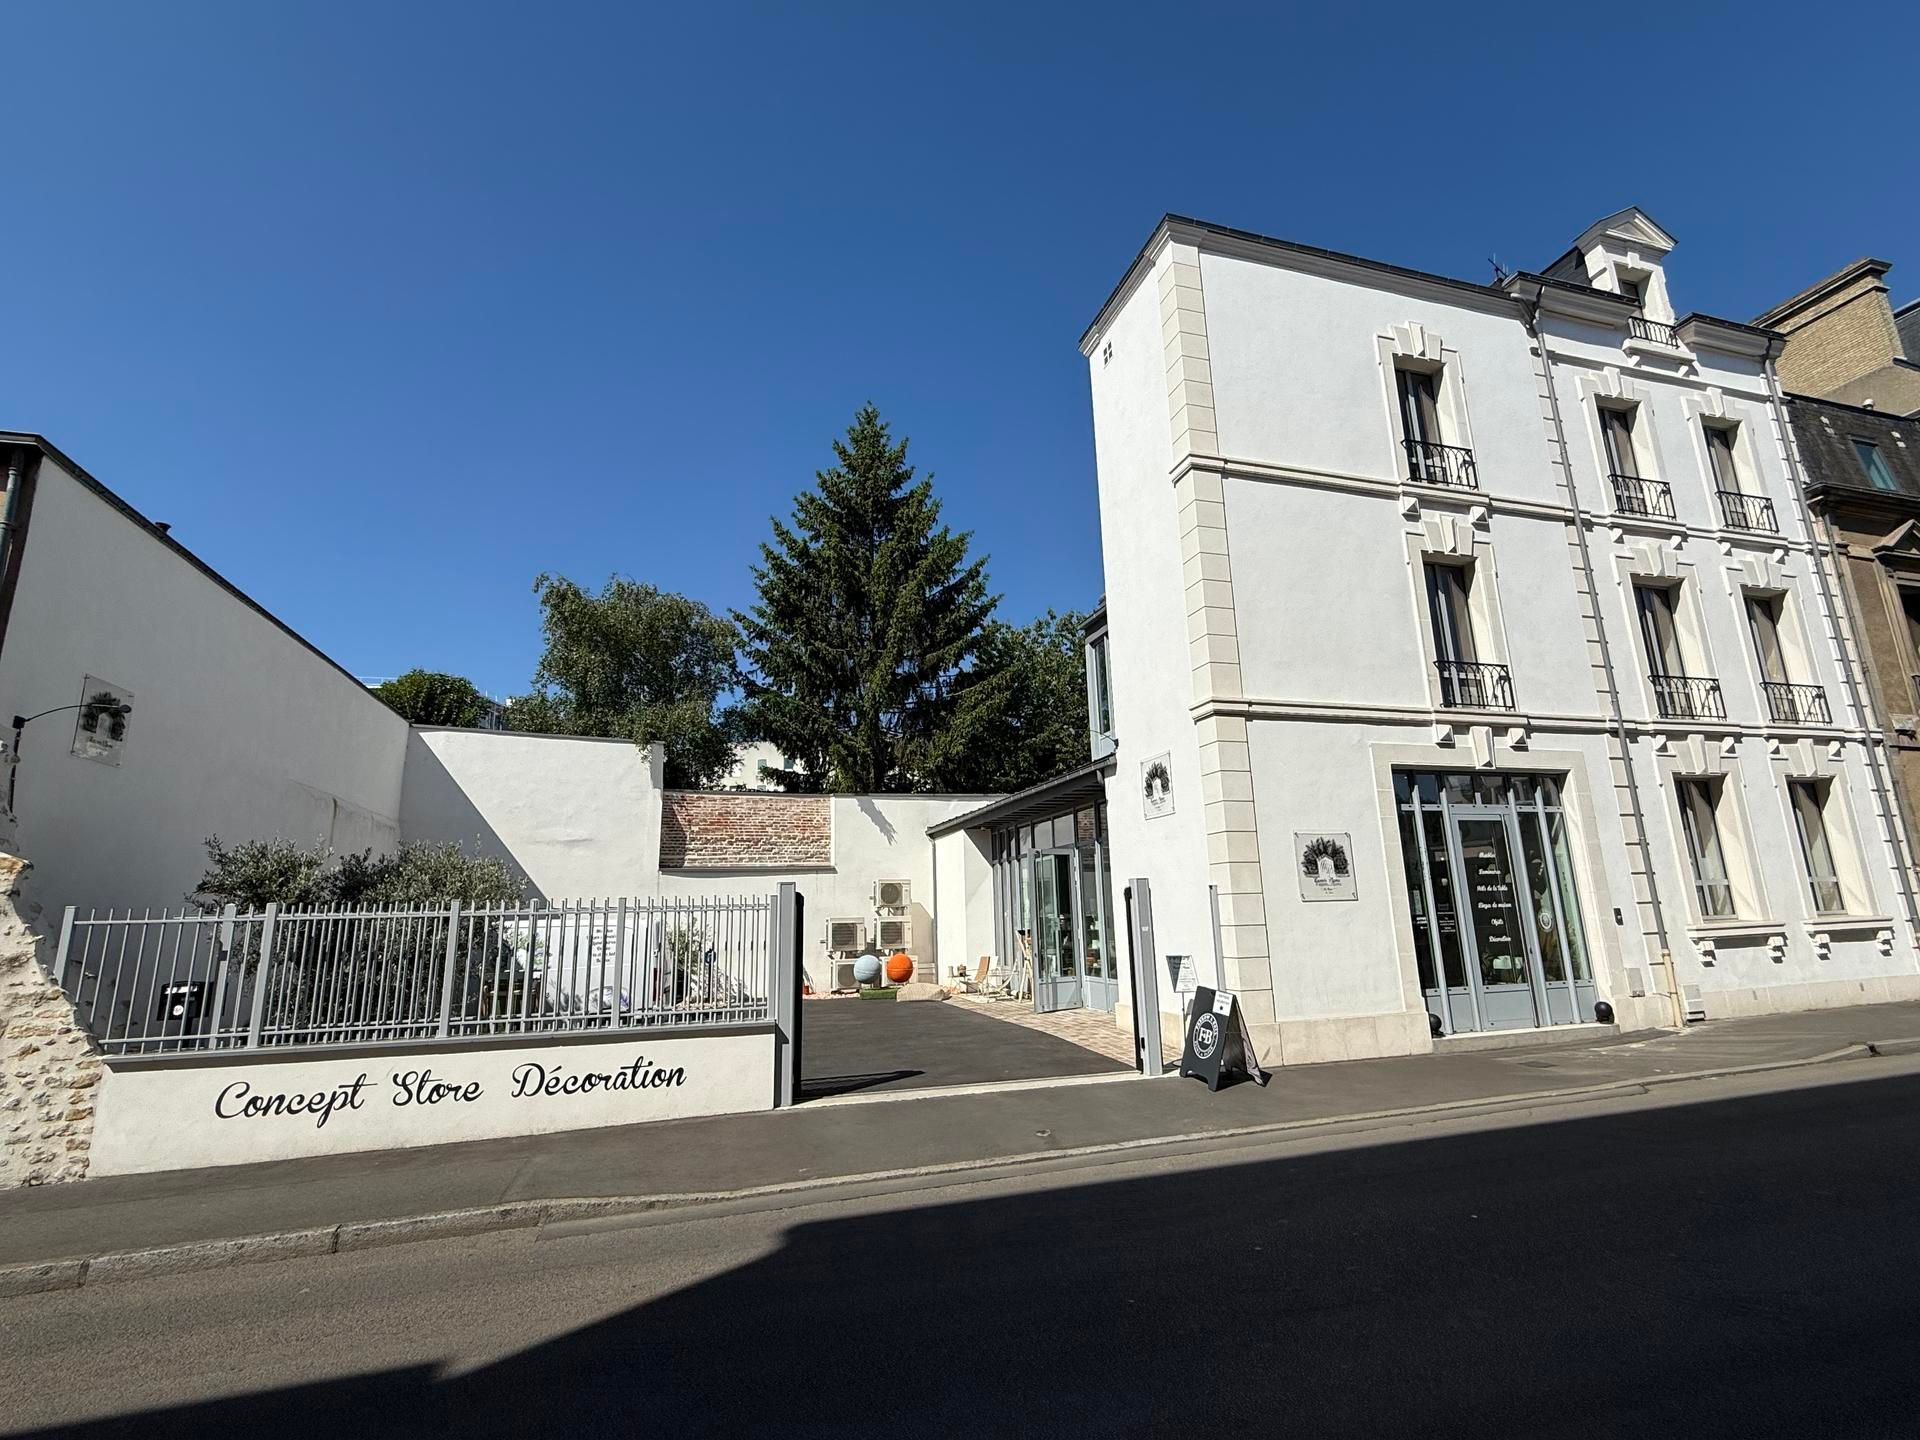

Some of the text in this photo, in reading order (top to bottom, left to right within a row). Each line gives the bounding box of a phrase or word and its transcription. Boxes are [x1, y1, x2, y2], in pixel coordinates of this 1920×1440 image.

[215, 1055, 687, 1128] Concept Store Décoration
